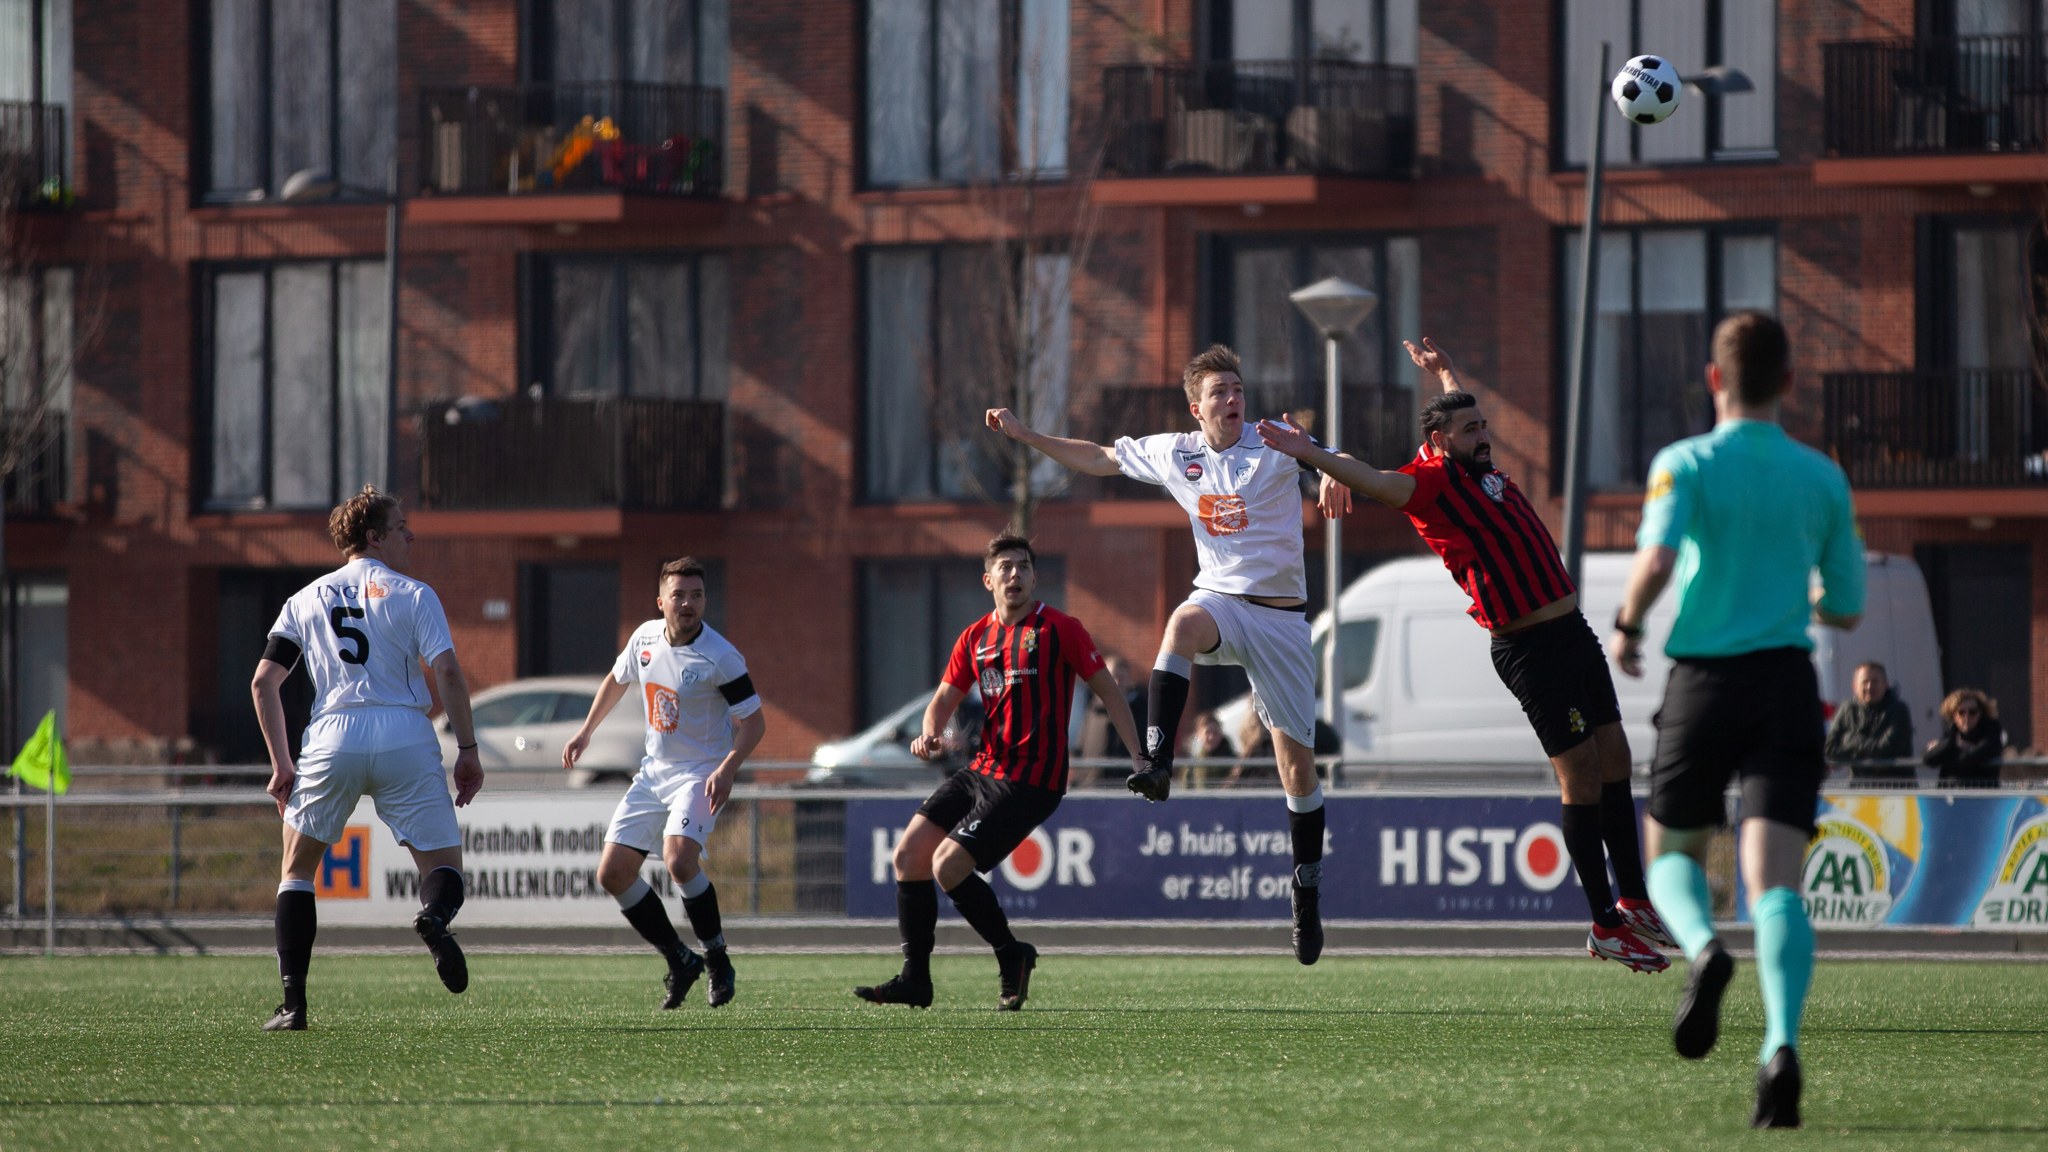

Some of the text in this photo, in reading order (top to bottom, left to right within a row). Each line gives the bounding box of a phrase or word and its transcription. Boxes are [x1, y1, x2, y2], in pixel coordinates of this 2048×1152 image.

[317, 584, 359, 599] ING
[331, 606, 369, 665] 5
[461, 823, 604, 853] lenhok nodi
[681, 817, 690, 830] 9
[969, 820, 981, 832] 6
[1140, 822, 1333, 857] Je huis vrat
[322, 836, 362, 888] H
[871, 826, 1096, 891] HOR
[1380, 822, 1614, 891] HISTO
[1809, 850, 1863, 897] AA
[1162, 874, 1193, 900] er
[1199, 865, 1252, 900] zelf
